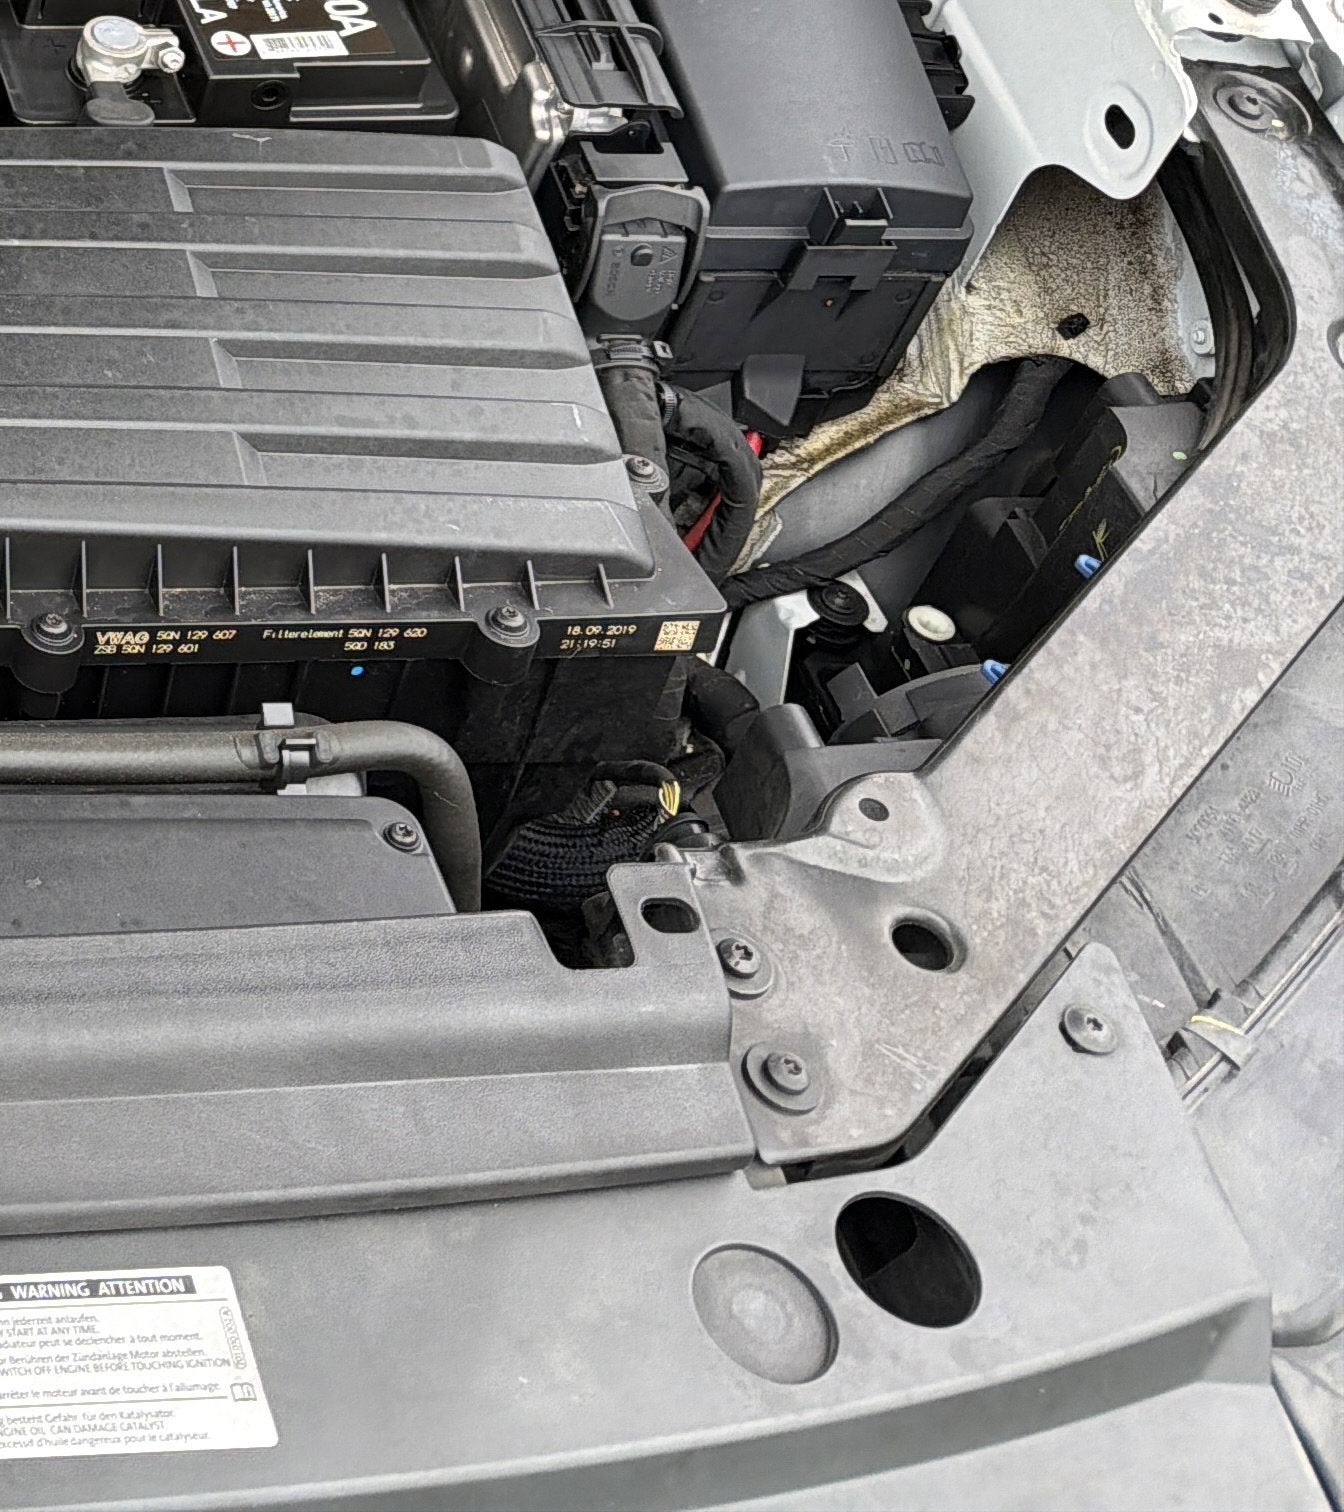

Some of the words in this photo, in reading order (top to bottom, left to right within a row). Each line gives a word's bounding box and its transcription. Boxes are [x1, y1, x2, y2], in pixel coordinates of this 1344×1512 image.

[263, 628, 343, 639] Filterelement
[378, 628, 399, 638] 129
[403, 627, 428, 638] 620
[567, 624, 637, 636] 18.09.2019
[96, 631, 150, 645] VWAG
[187, 630, 208, 640] 129
[212, 629, 237, 640] 607
[152, 644, 173, 654] 129
[177, 644, 199, 653] 601
[373, 640, 396, 651] 183
[560, 638, 617, 649] 21:19:51
[9, 1281, 90, 1299] WARNING
[95, 1277, 186, 1295] ATTENTION
